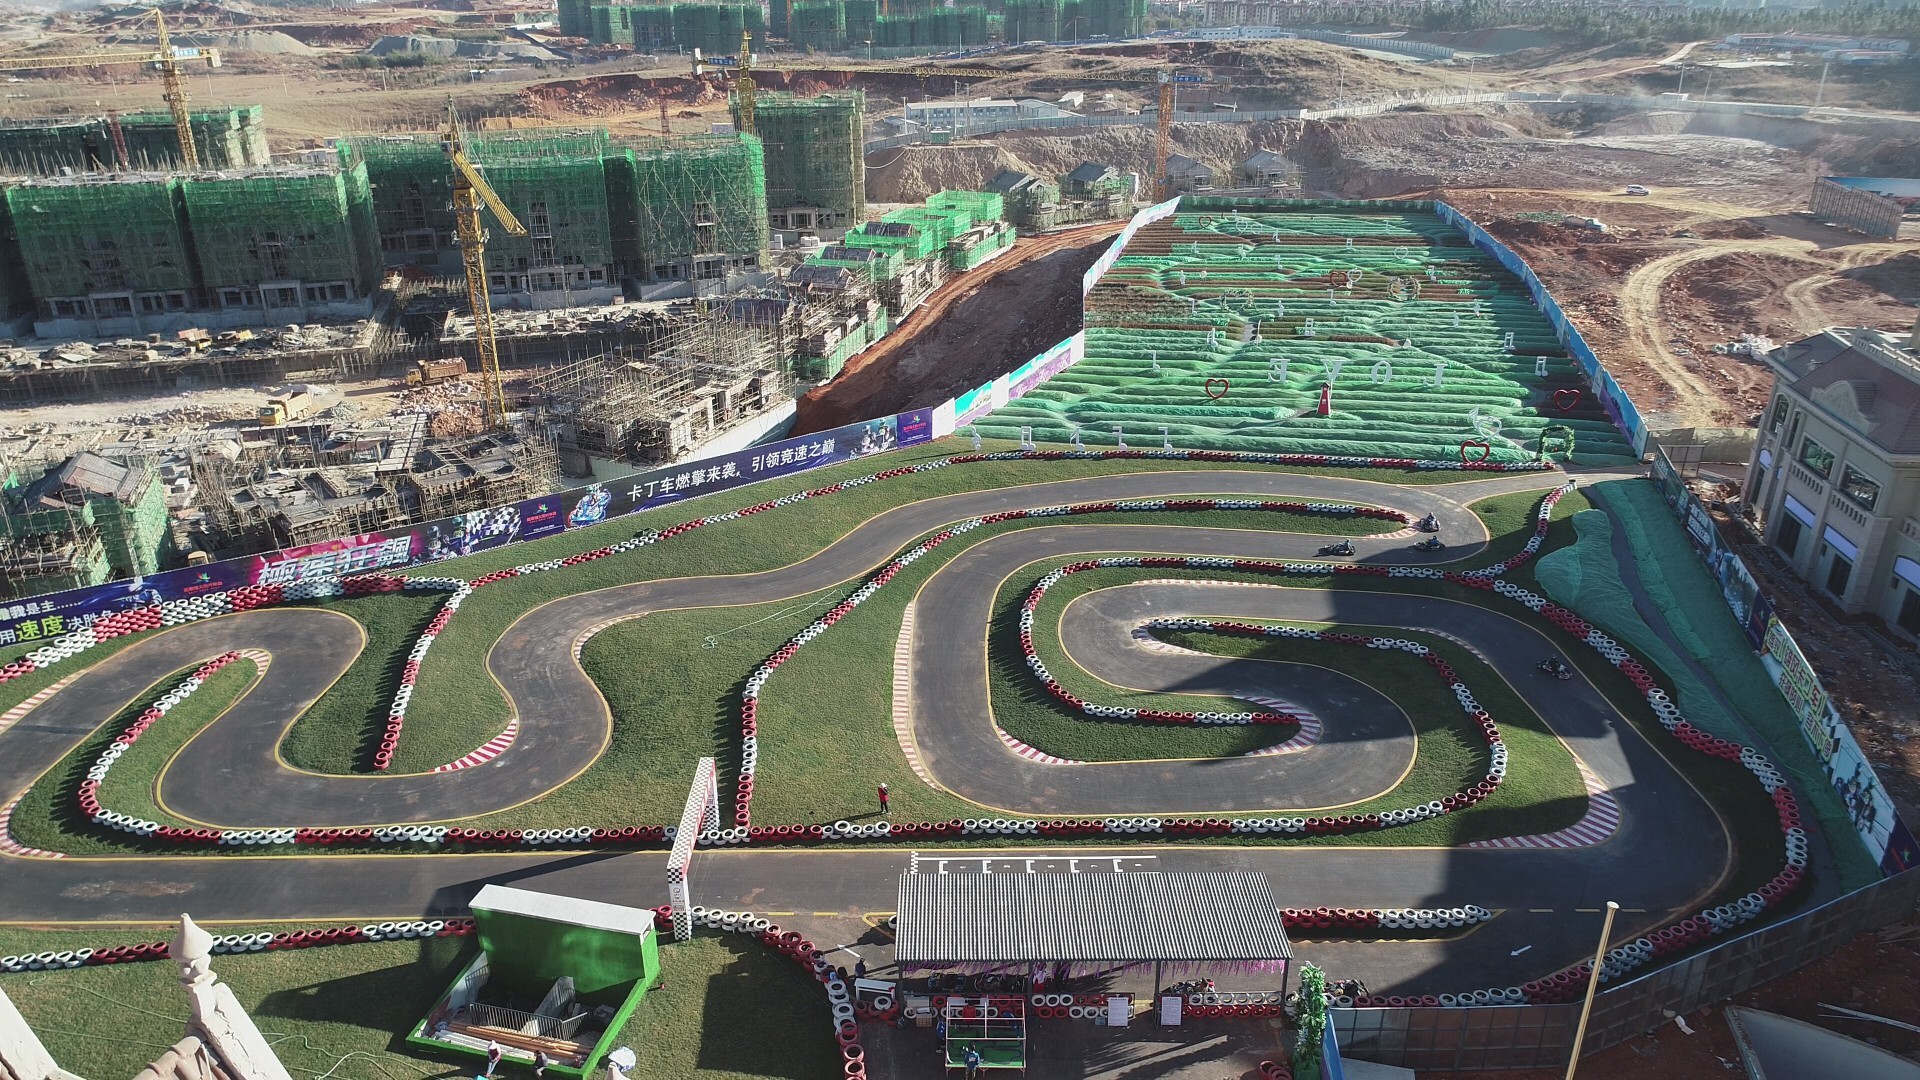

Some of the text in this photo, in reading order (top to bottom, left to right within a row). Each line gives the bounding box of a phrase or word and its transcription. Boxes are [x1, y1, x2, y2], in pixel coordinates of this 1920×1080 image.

[751, 438, 836, 472] 引领竞速之巅
